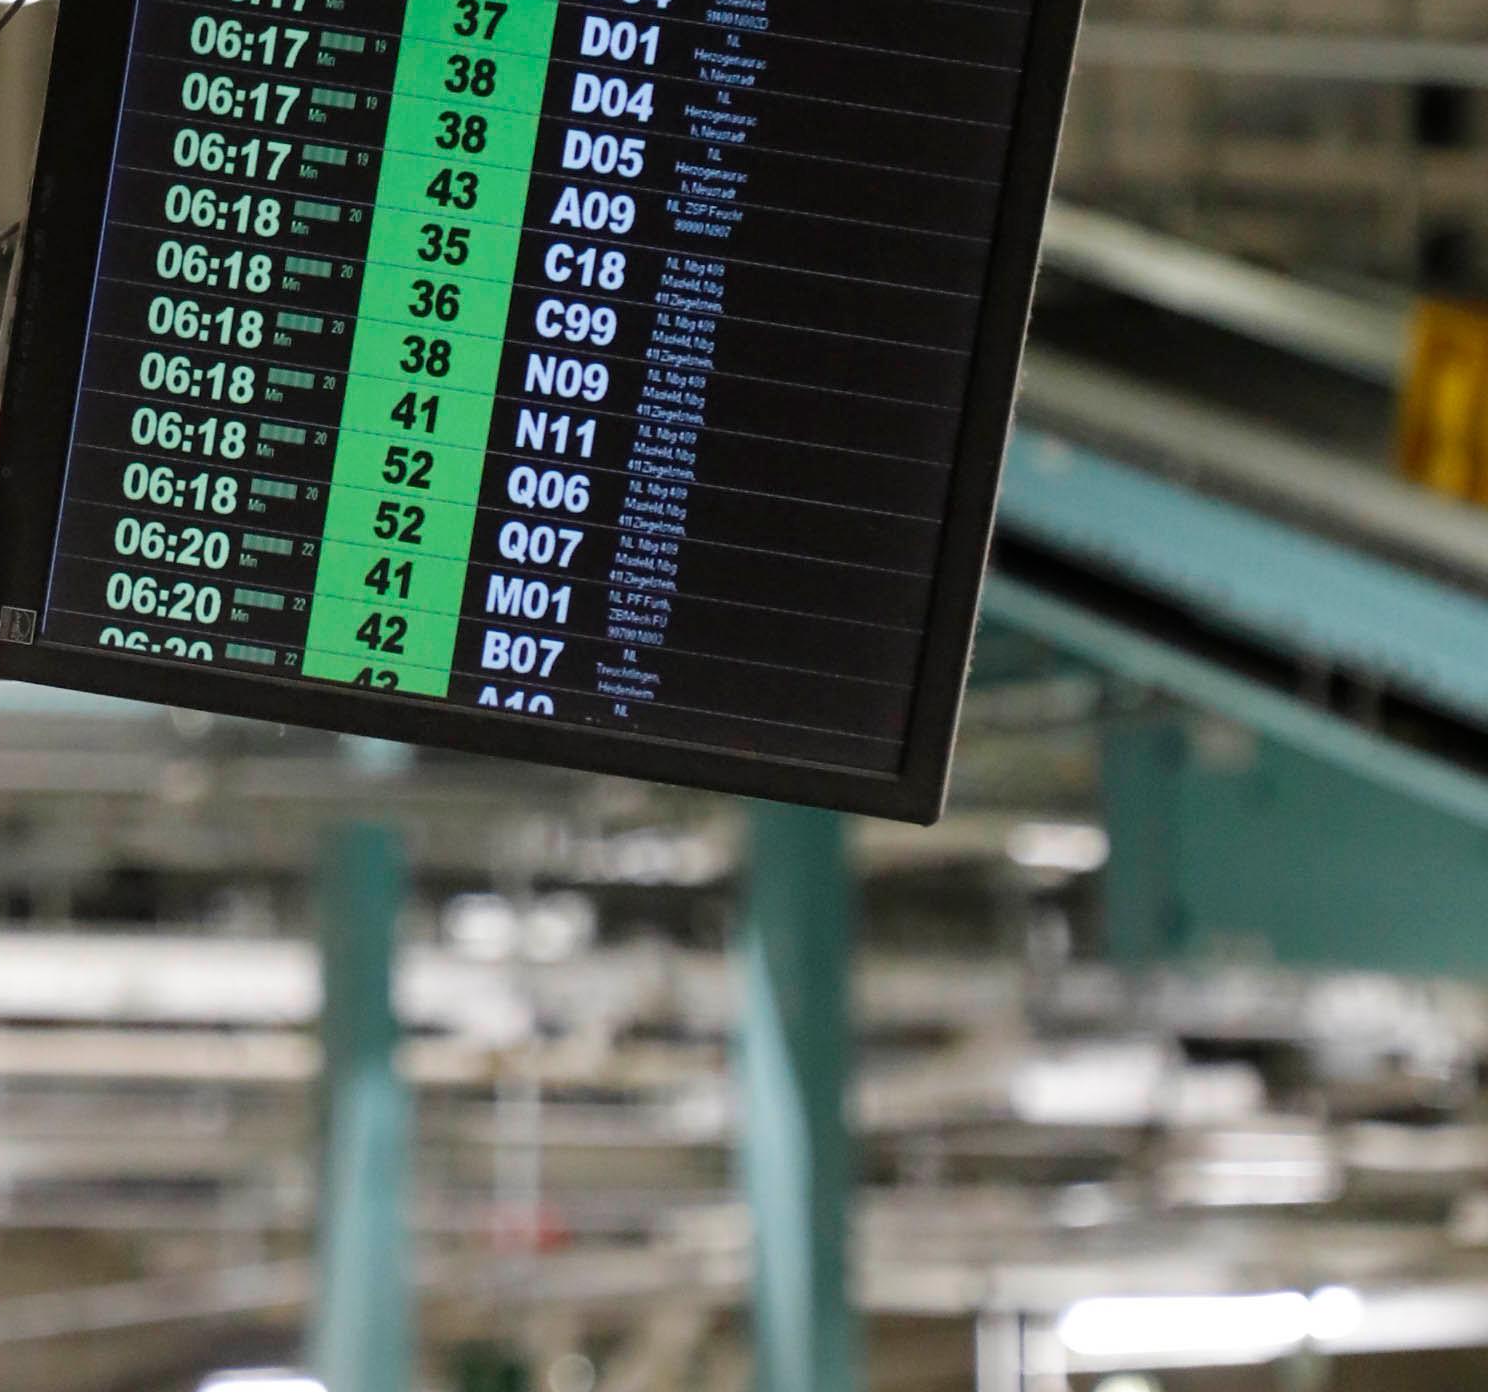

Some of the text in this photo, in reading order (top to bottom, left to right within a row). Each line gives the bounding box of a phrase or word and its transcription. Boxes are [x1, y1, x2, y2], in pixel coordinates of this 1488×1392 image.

[580, 15, 660, 65] D01
[190, 15, 310, 69] 06:17
[444, 54, 497, 98] 38
[571, 72, 654, 122] D04
[314, 49, 339, 69] Min
[181, 72, 301, 125] 06:17
[435, 110, 488, 154] 38
[561, 128, 646, 178] D05
[305, 106, 330, 126] Min
[173, 128, 292, 181] 06:17
[425, 168, 479, 210] 43
[550, 186, 636, 234] A09
[297, 162, 321, 182] Min
[164, 184, 281, 237] 06:18
[347, 206, 365, 224] 20
[417, 223, 471, 266] 35
[544, 242, 626, 291] C18
[288, 218, 313, 238] Min
[156, 240, 617, 346] 06:18 20 36 C99
[279, 274, 304, 294] Min
[147, 296, 609, 402] 06:18 20 38 N09
[271, 330, 295, 350] Min
[139, 351, 596, 458] 06:18 20 41 N11
[262, 386, 287, 405] Min
[131, 407, 590, 513] 06:18 20 52 Q06
[254, 441, 278, 460] Min
[122, 462, 584, 568] 06:18 20 52 Q07
[245, 496, 269, 515] Min
[114, 517, 230, 570] 06:20
[299, 540, 317, 558] 22
[364, 557, 414, 599] 41
[485, 574, 572, 624] M01
[237, 551, 261, 571] Min
[106, 572, 222, 624] 06:20
[291, 594, 309, 613] 22
[355, 612, 408, 655] 42
[481, 630, 565, 678] B07
[228, 605, 252, 625] Min
[282, 649, 300, 667] 22
